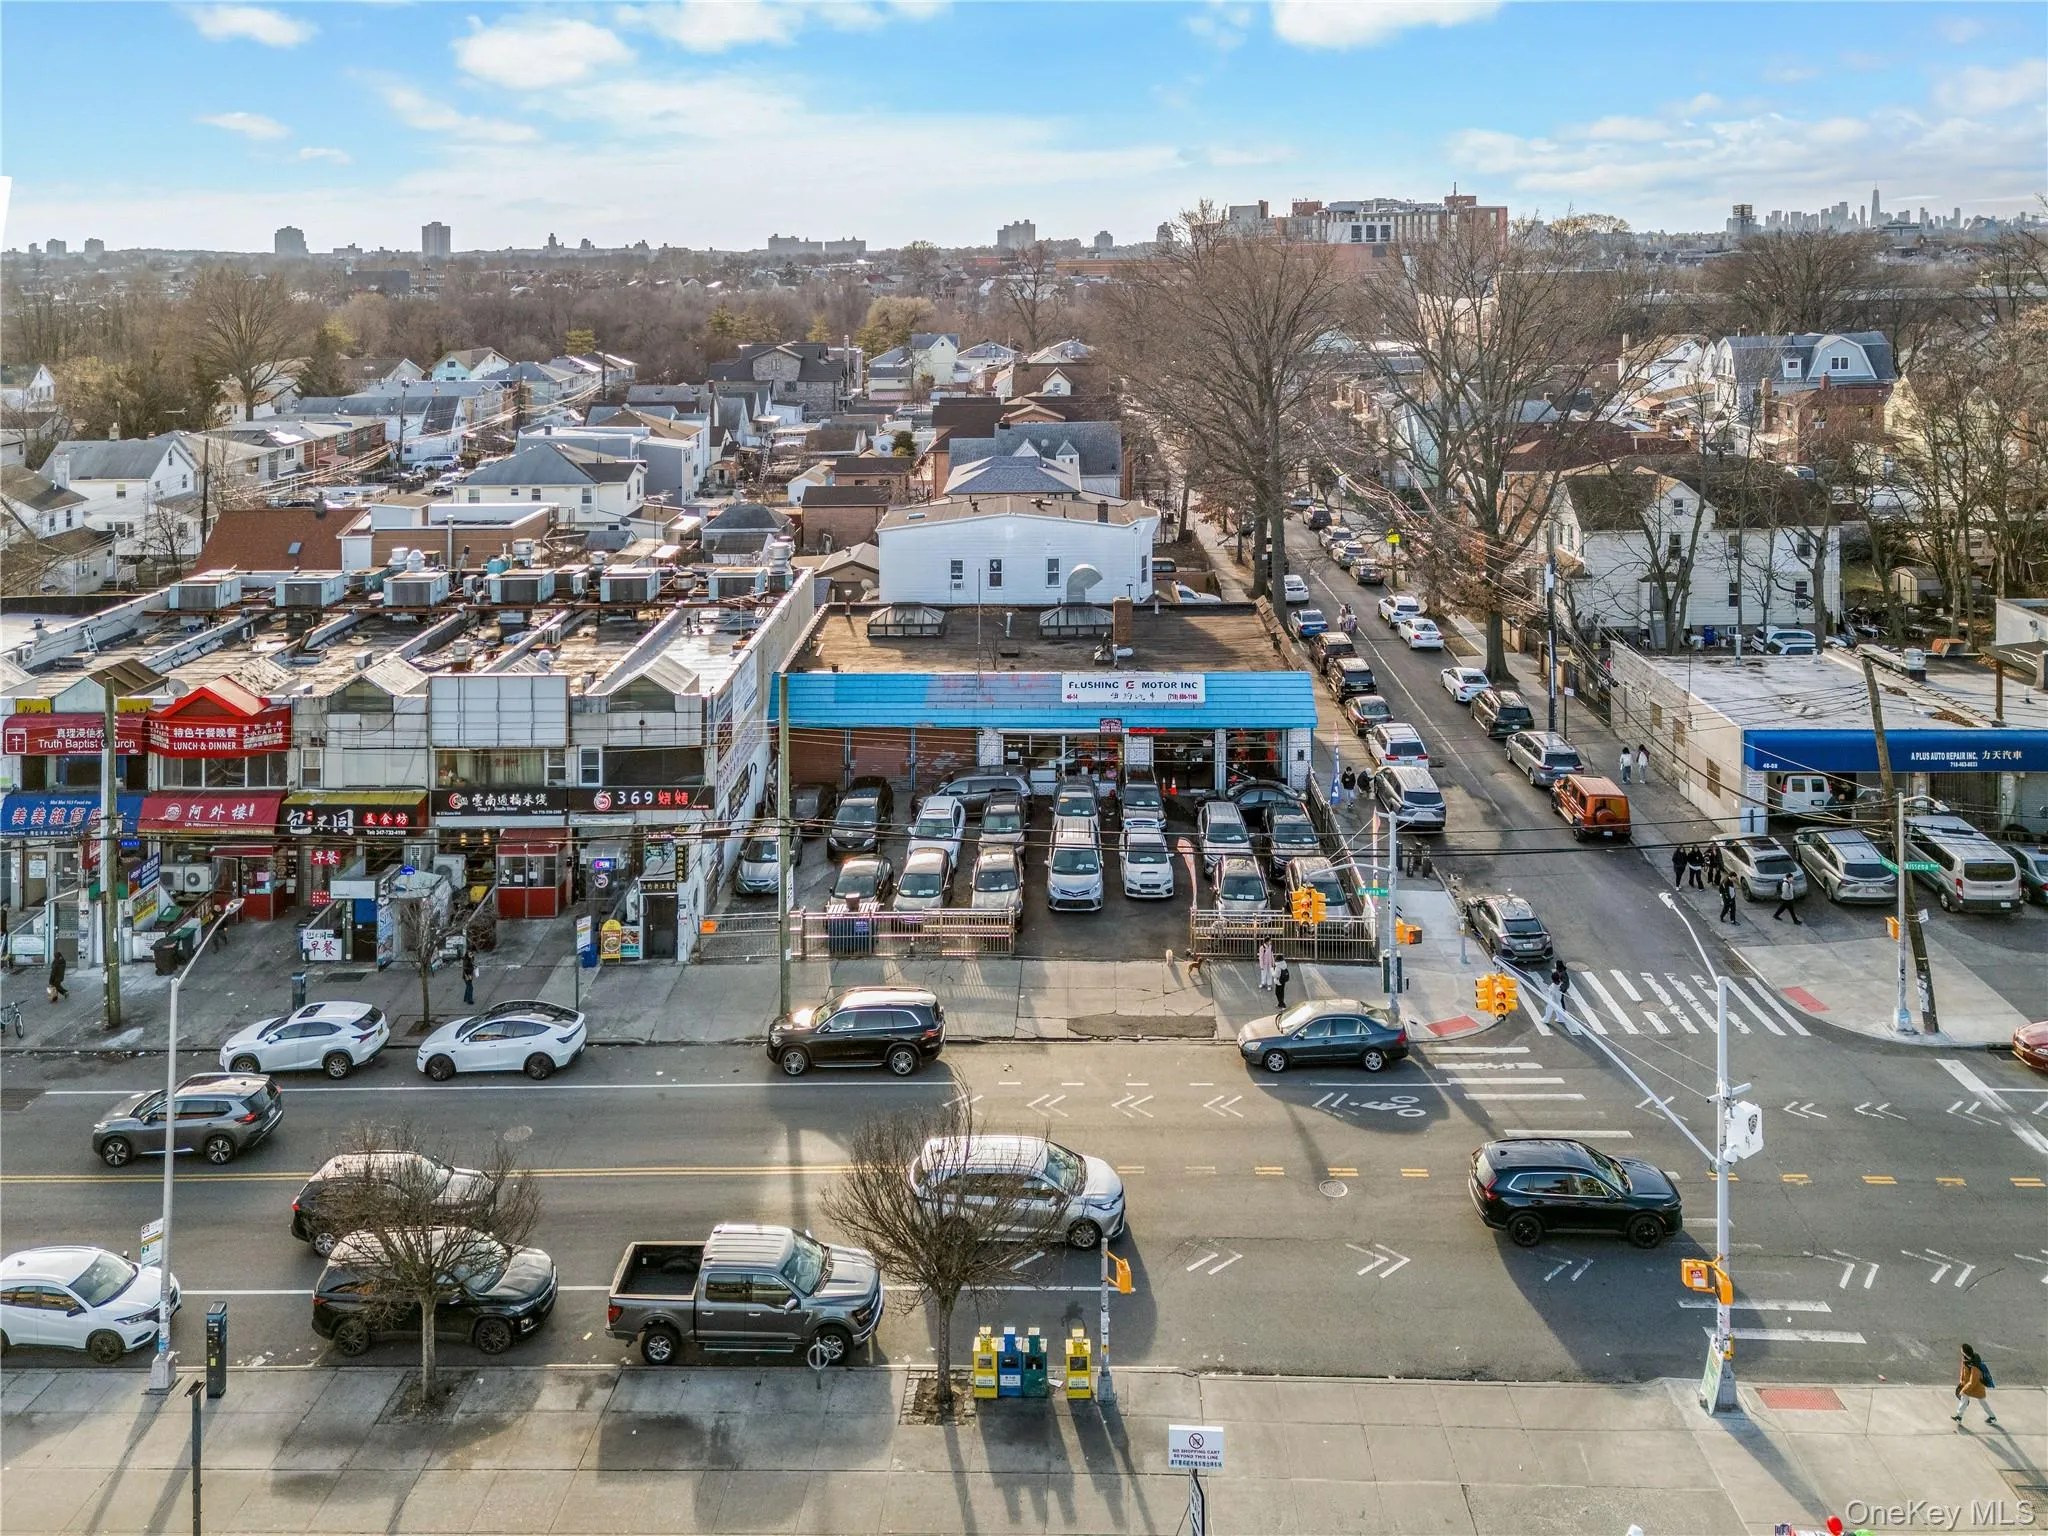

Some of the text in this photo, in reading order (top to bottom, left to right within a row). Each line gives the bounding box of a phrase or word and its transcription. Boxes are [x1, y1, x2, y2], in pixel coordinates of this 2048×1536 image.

[1069, 681, 1119, 689] FLUSHING
[1142, 681, 1177, 689] MOTOR
[1181, 681, 1198, 689] INC
[39, 740, 62, 749] Truth
[65, 740, 98, 752] Baptist
[101, 740, 135, 749] Curch
[174, 742, 237, 750] LUNCH & DINNER
[1911, 752, 1915, 760] A
[1916, 752, 1930, 760] PLUS
[1931, 752, 1945, 760] AUTO
[1946, 752, 1966, 760] REPAIR
[617, 791, 653, 805] 369
[1906, 863, 1928, 871] Kissena
